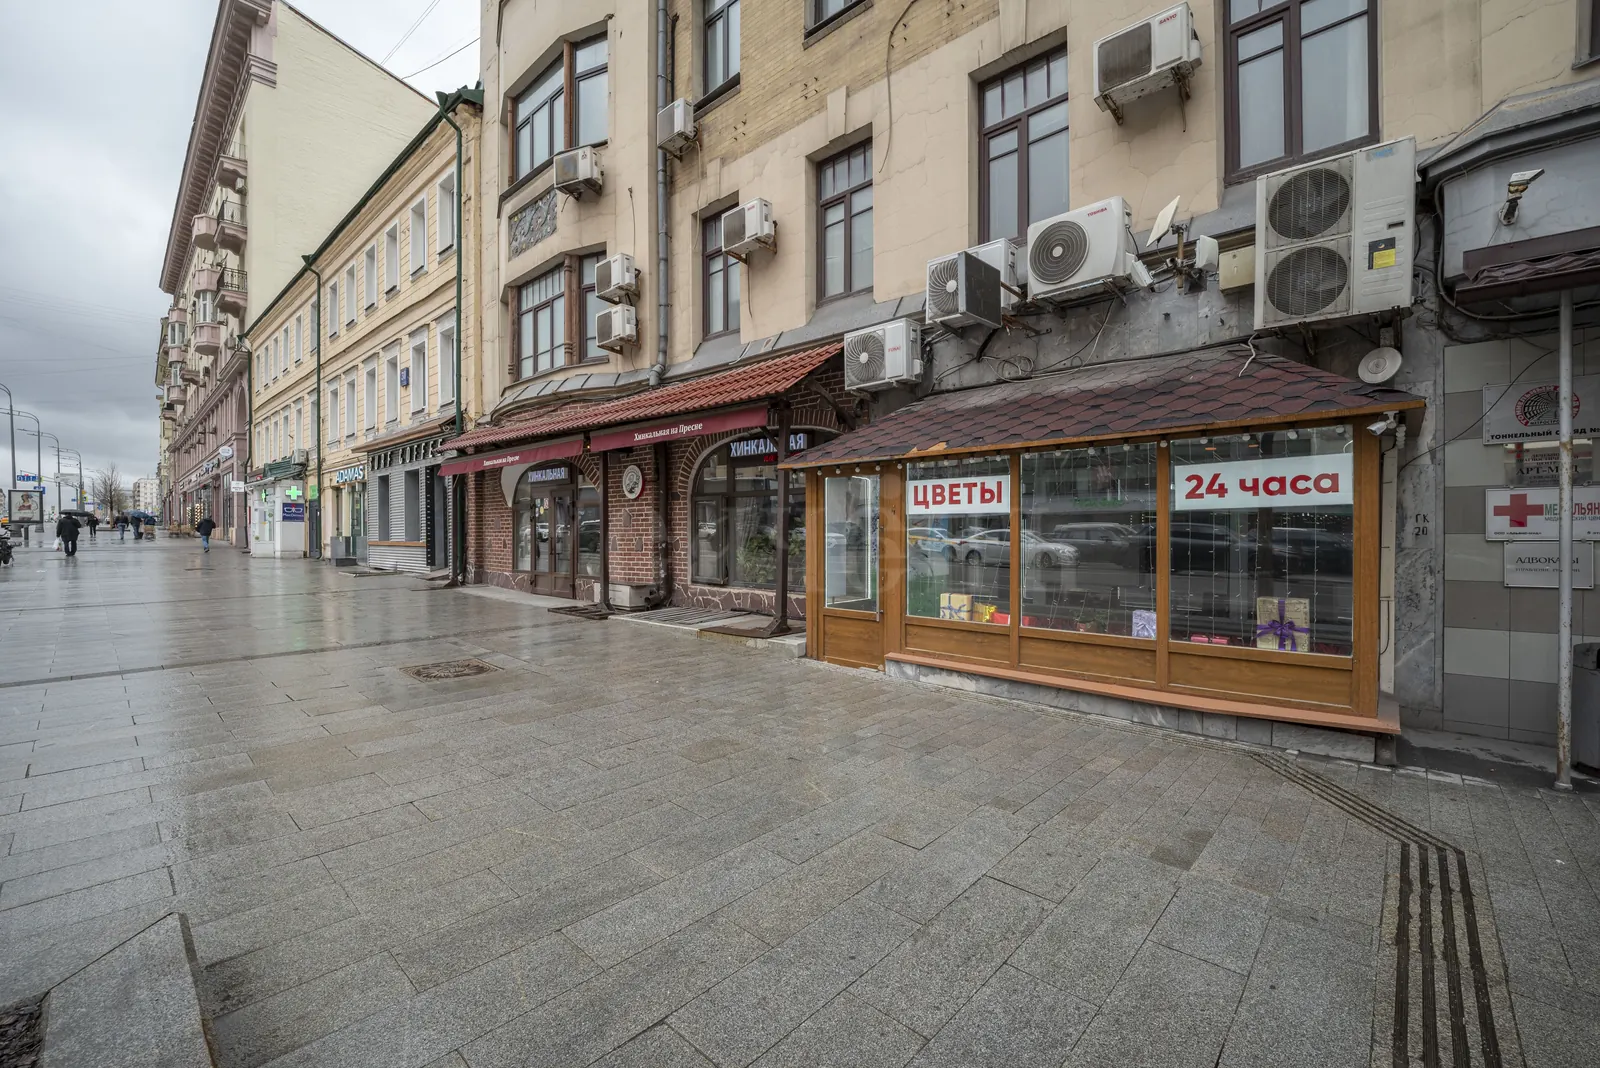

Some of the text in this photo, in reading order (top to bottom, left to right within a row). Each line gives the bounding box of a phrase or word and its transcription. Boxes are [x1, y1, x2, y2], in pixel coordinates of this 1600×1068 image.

[1159, 13, 1177, 24] SANYO
[1087, 207, 1107, 217] TOSHIBA
[634, 428, 669, 441] Хинкальная
[679, 422, 703, 434] Пресне
[1490, 429, 1552, 440] ТОННЕЛЬНЫЙ
[1555, 428, 1587, 436] ОЯД
[730, 433, 803, 457] ХИНКАЛАЯ
[336, 465, 363, 483] ADAMAS
[527, 467, 565, 482] ХИНКАЛЬНАЯ
[1516, 464, 1580, 475] АРТ-МД
[1185, 473, 1339, 499] 24 часа
[913, 480, 1003, 509] ЦВЕТЫ
[1545, 503, 1600, 516] МЕЛЬЯН
[1414, 526, 1428, 536] 20
[1516, 556, 1579, 564] АДВОКАЫ
